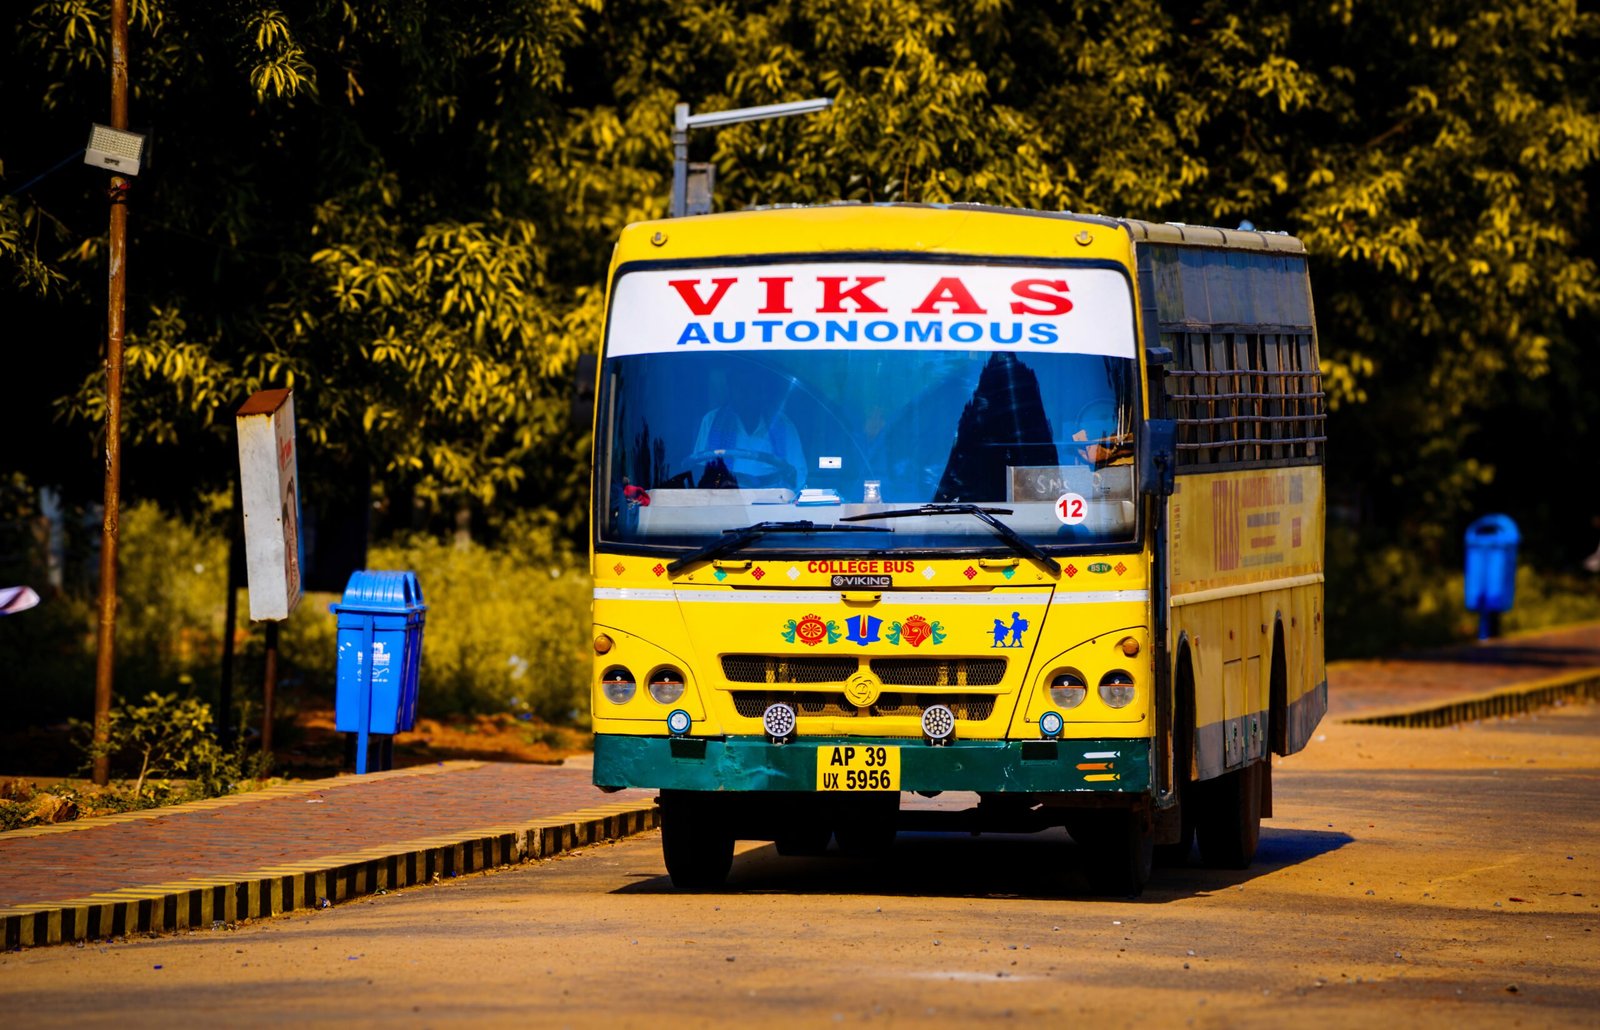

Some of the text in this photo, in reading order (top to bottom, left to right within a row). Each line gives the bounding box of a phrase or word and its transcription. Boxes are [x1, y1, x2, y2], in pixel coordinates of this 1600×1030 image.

[668, 275, 1074, 316] VIKAS
[676, 319, 1059, 345] AUTONOMOUS
[1058, 499, 1083, 518] 12
[807, 560, 915, 574] COLLEGE BUS
[845, 576, 890, 586] VIKING
[830, 747, 887, 767] AP 39
[823, 770, 891, 790] UX 5956
